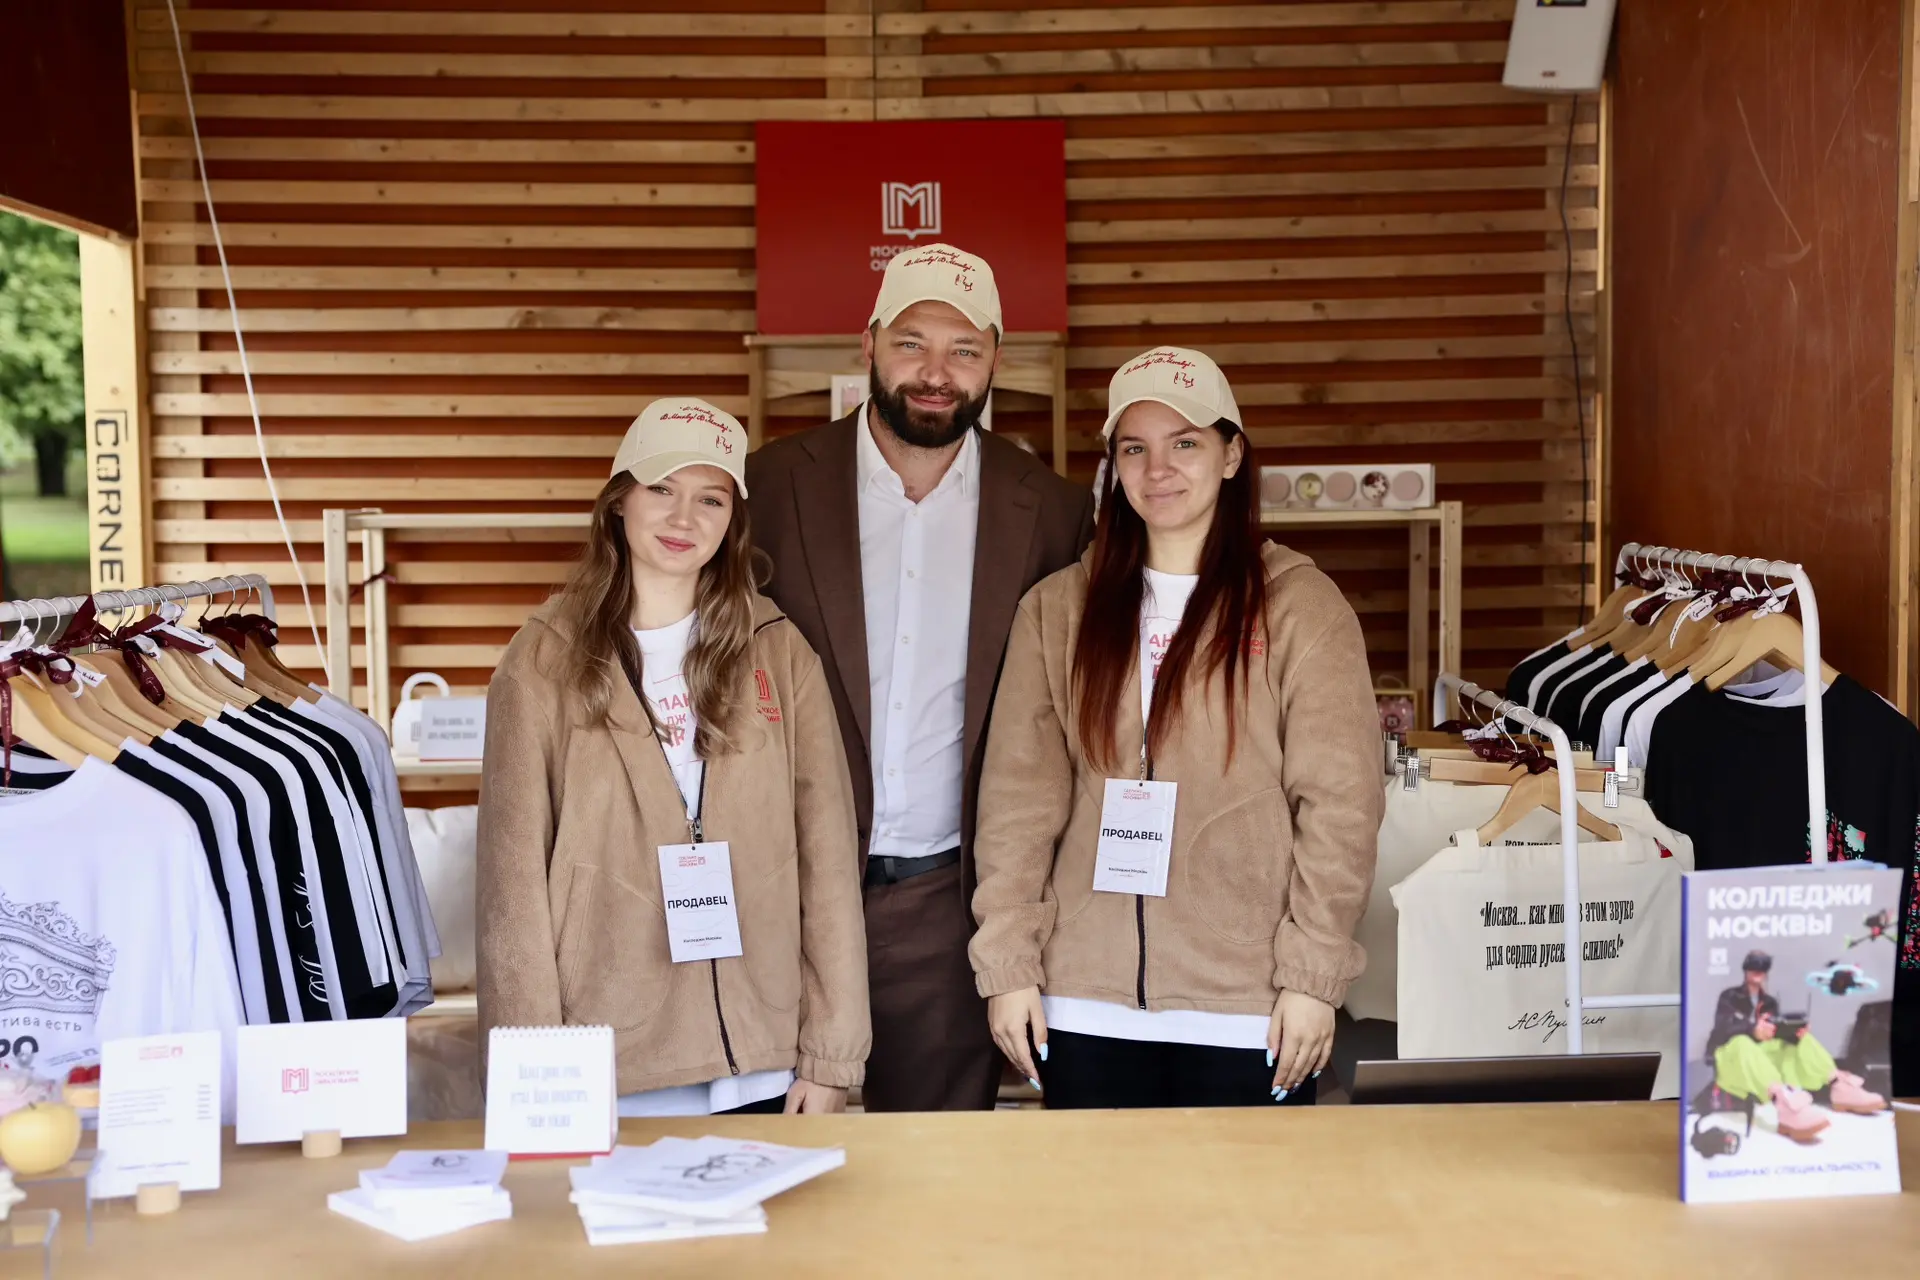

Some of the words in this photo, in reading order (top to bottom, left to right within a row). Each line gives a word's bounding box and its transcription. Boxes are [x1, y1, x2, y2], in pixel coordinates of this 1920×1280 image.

[1102, 828, 1163, 842] ПРОДАВЕЦ
[667, 895, 728, 909] ПРОДАВЕЦ
[1707, 883, 1873, 911] КОЛЛЕДЖИ
[1529, 904, 1547, 925] как
[1548, 903, 1565, 924] мно
[1585, 901, 1608, 922] этом
[1609, 899, 1634, 925] звуке
[1707, 912, 1833, 940] МОСКВЫ
[1485, 945, 1504, 971] для
[1505, 943, 1537, 969] сердца
[1539, 942, 1566, 968] русск
[0, 1016, 40, 1029] тива
[45, 1019, 82, 1032] есть
